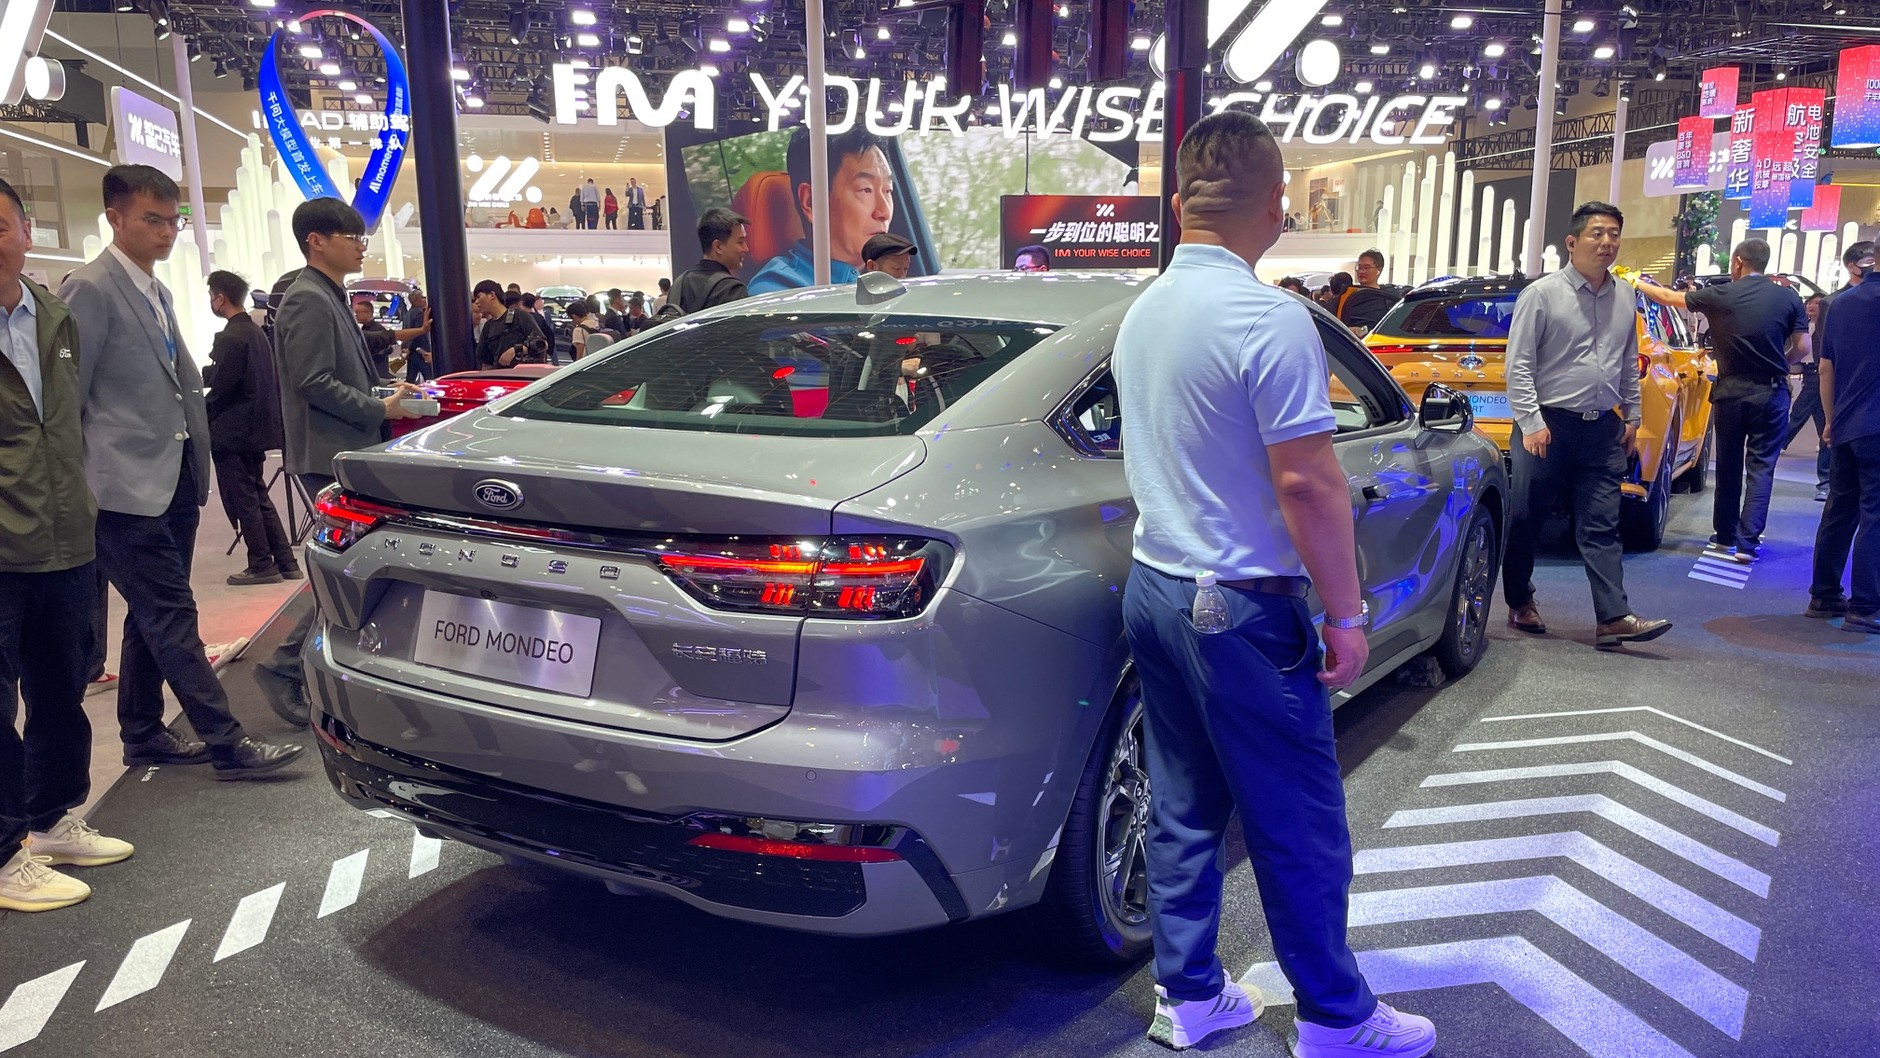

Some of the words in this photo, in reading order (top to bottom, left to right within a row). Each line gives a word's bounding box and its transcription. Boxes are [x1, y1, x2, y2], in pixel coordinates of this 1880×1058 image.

[553, 64, 715, 130] IM
[749, 72, 972, 138] YOUR
[144, 119, 181, 158] 智己汽车
[267, 91, 324, 196] 千问大模型首发上车
[348, 113, 412, 132] 辅助驾
[1801, 104, 1822, 179] 电池安全
[1728, 107, 1756, 193] 新奢华
[1029, 221, 1160, 243] 一步到位的聪明之
[1073, 249, 1096, 257] YOUR
[1099, 249, 1119, 257] WISE
[1121, 249, 1151, 257] CHOICE
[483, 487, 508, 503] Ford
[434, 619, 481, 646] FORD
[485, 629, 574, 664] MONDEO
